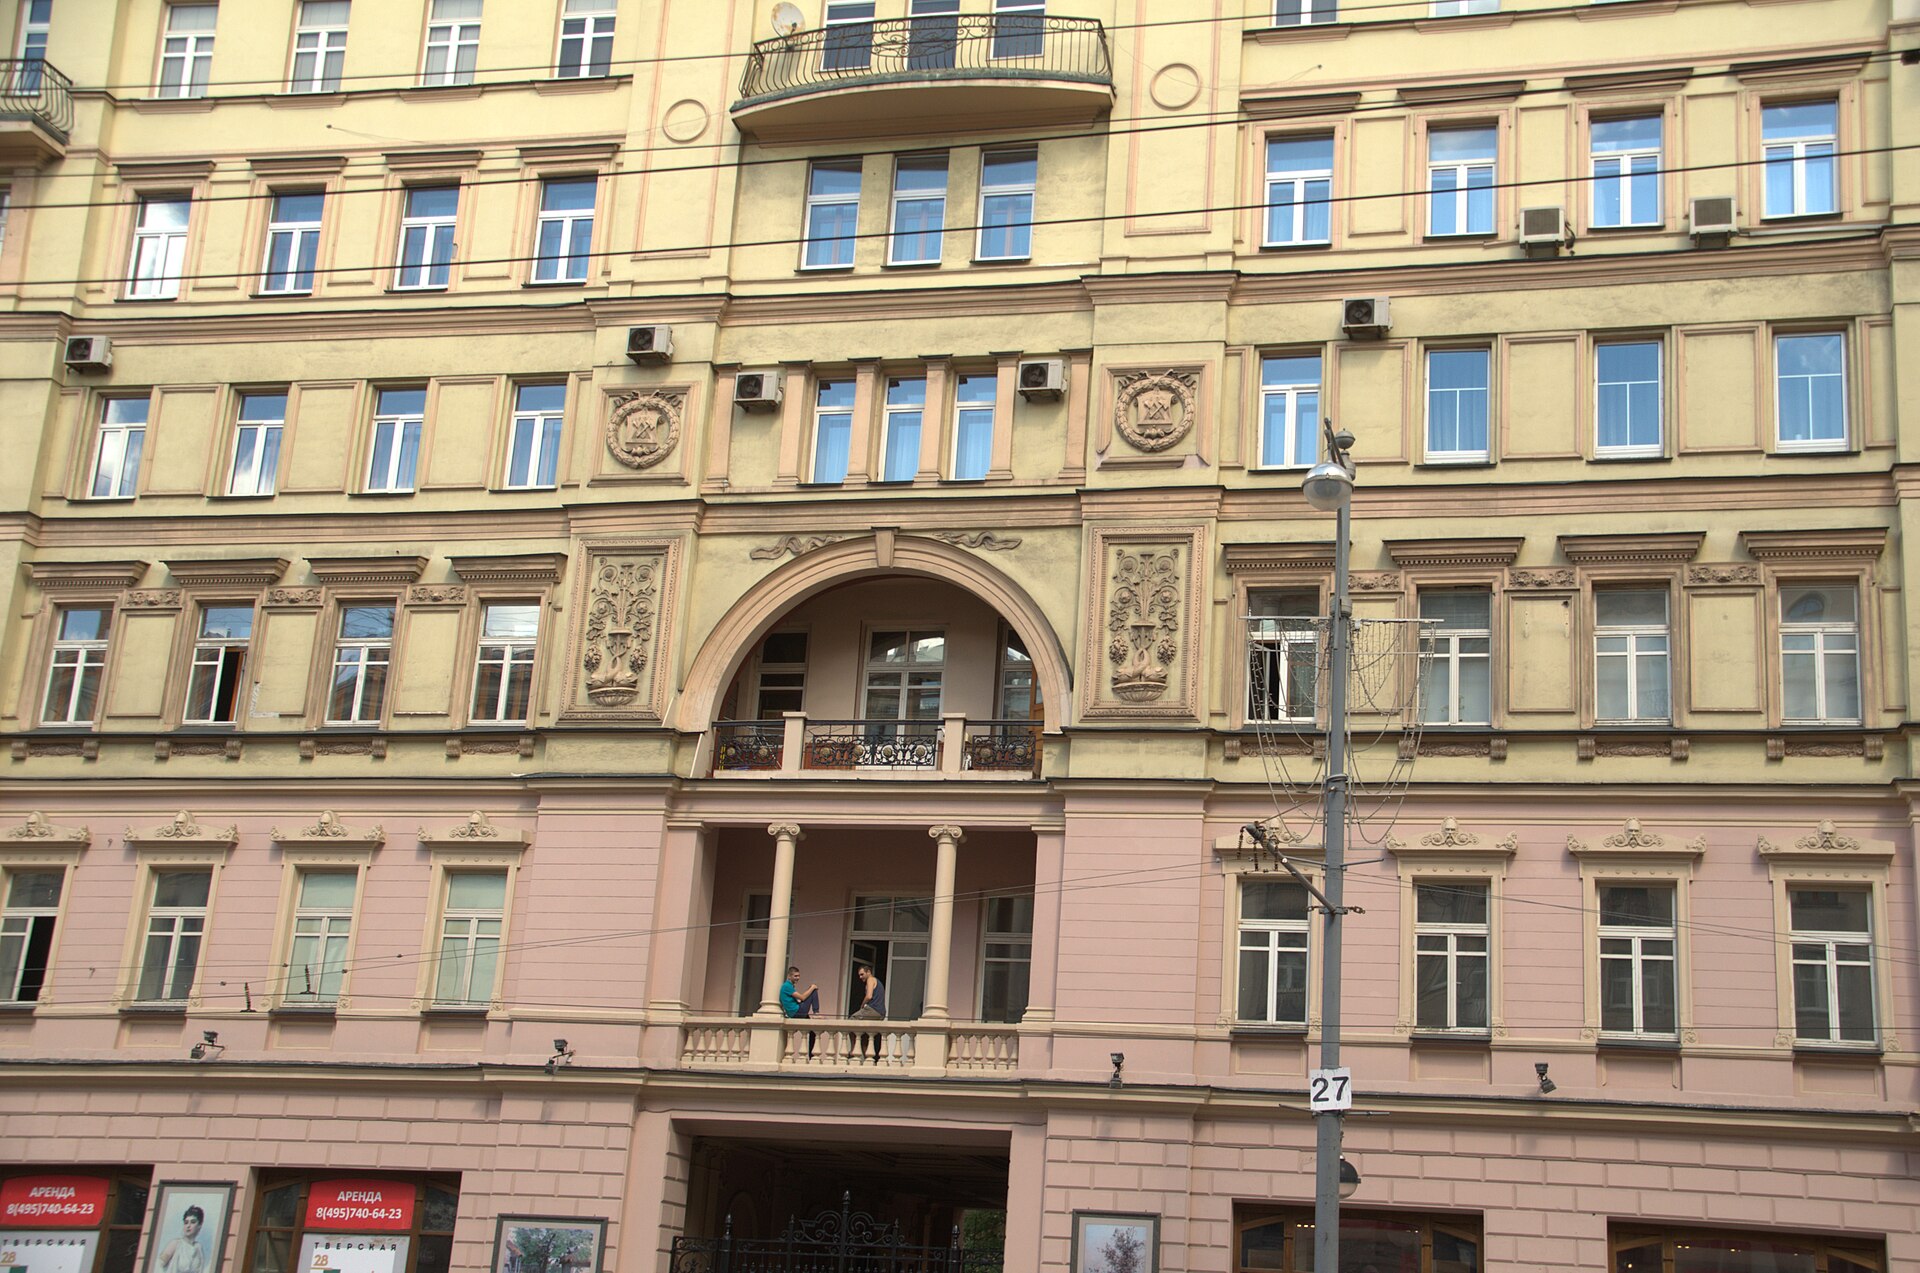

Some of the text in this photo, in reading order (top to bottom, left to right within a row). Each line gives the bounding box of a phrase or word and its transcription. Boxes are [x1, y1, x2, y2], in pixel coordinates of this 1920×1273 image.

[1312, 1076, 1349, 1102] 27
[29, 1186, 76, 1199] АРЕНДА
[337, 1191, 382, 1204] АРЕНДА
[6, 1203, 95, 1216] 8(495)740-64-23
[316, 1207, 402, 1220] 8(495)740-64-23
[3, 1239, 87, 1247] ТВЕРСКАЯ
[314, 1242, 397, 1251] ТВЕРСКАЯ
[2, 1251, 17, 1264] 28
[313, 1254, 329, 1267] 28
